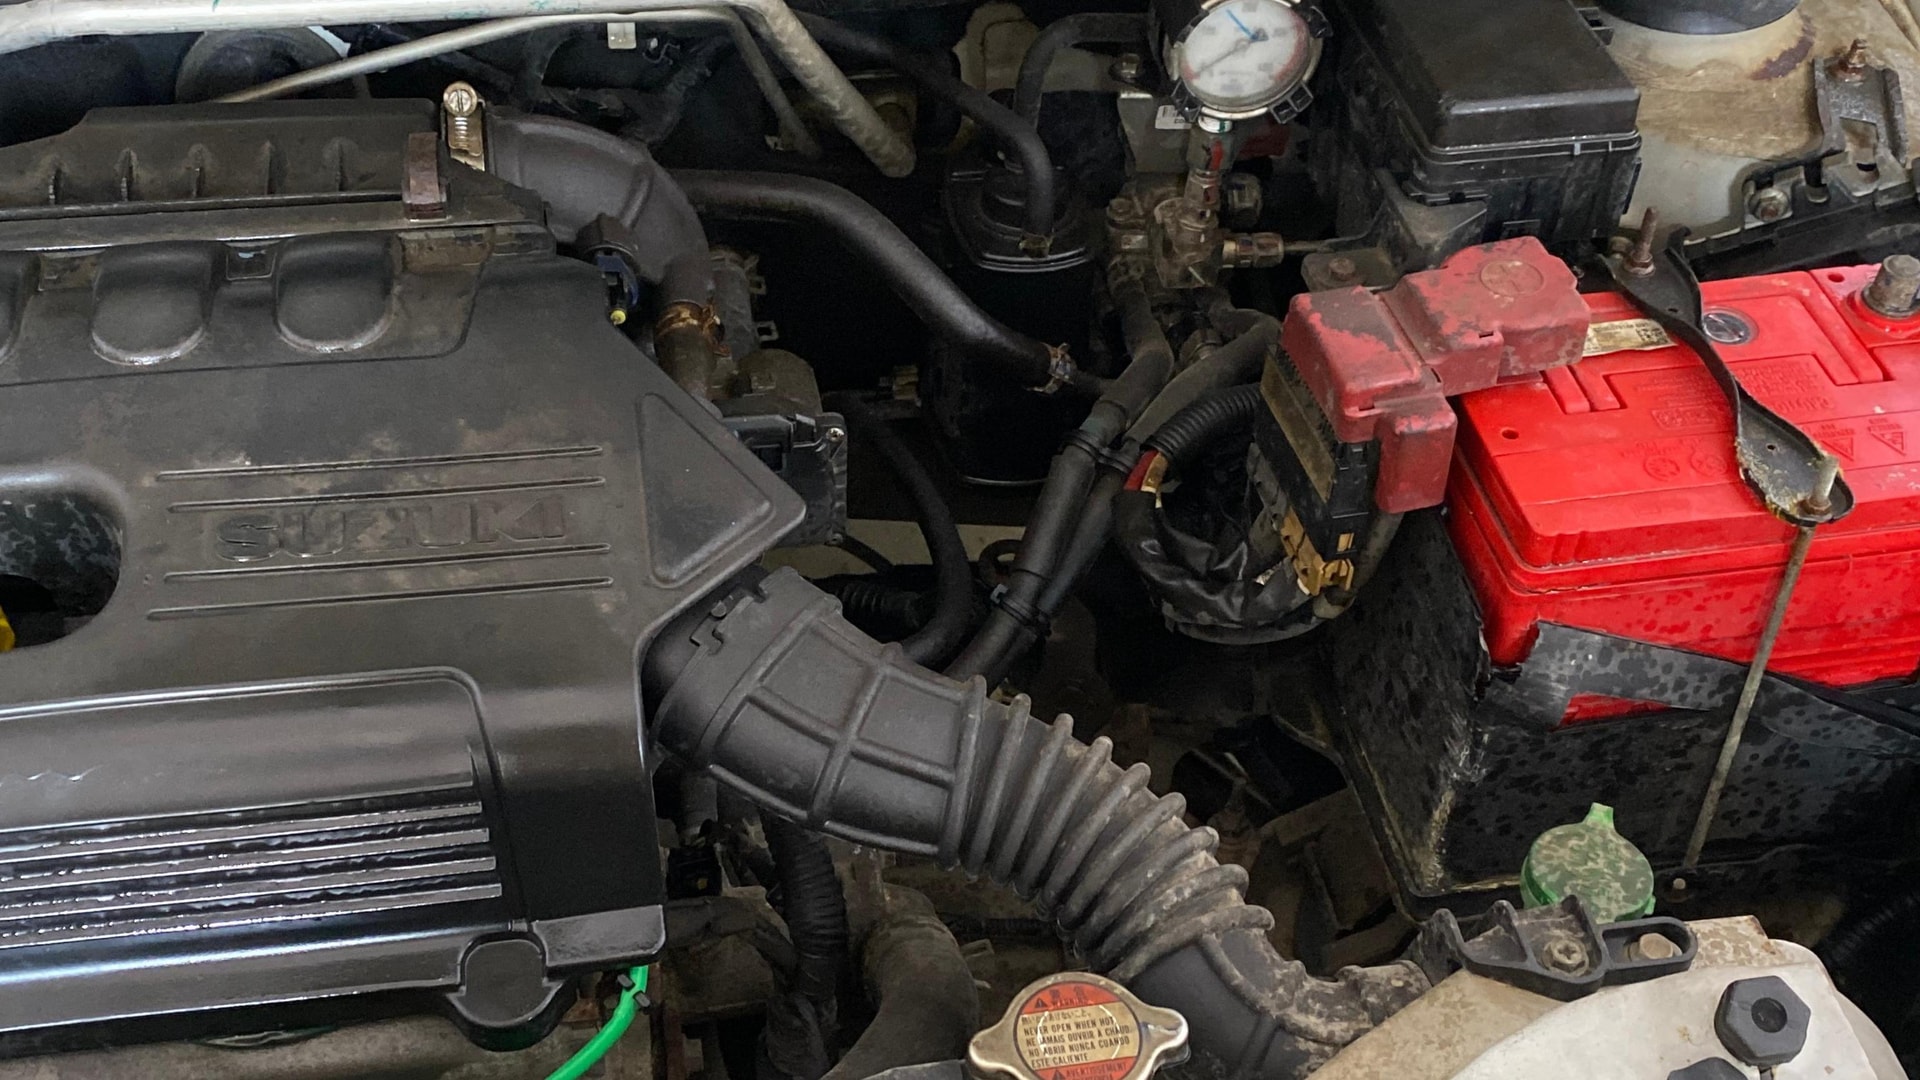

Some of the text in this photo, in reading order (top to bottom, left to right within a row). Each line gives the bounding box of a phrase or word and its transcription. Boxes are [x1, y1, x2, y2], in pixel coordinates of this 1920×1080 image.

[1051, 1023, 1072, 1033] OPEN
[1074, 1019, 1097, 1030] WHEN
[1099, 1016, 1114, 1026] HOT
[1026, 1038, 1036, 1047] NE
[1068, 1030, 1095, 1041] OUVRIR
[1105, 1025, 1130, 1036] CHAUD
[1028, 1036, 1130, 1057] NO ABRIR NUNCA CUANDO
[1031, 1053, 1088, 1068] ESTE CALIENTE
